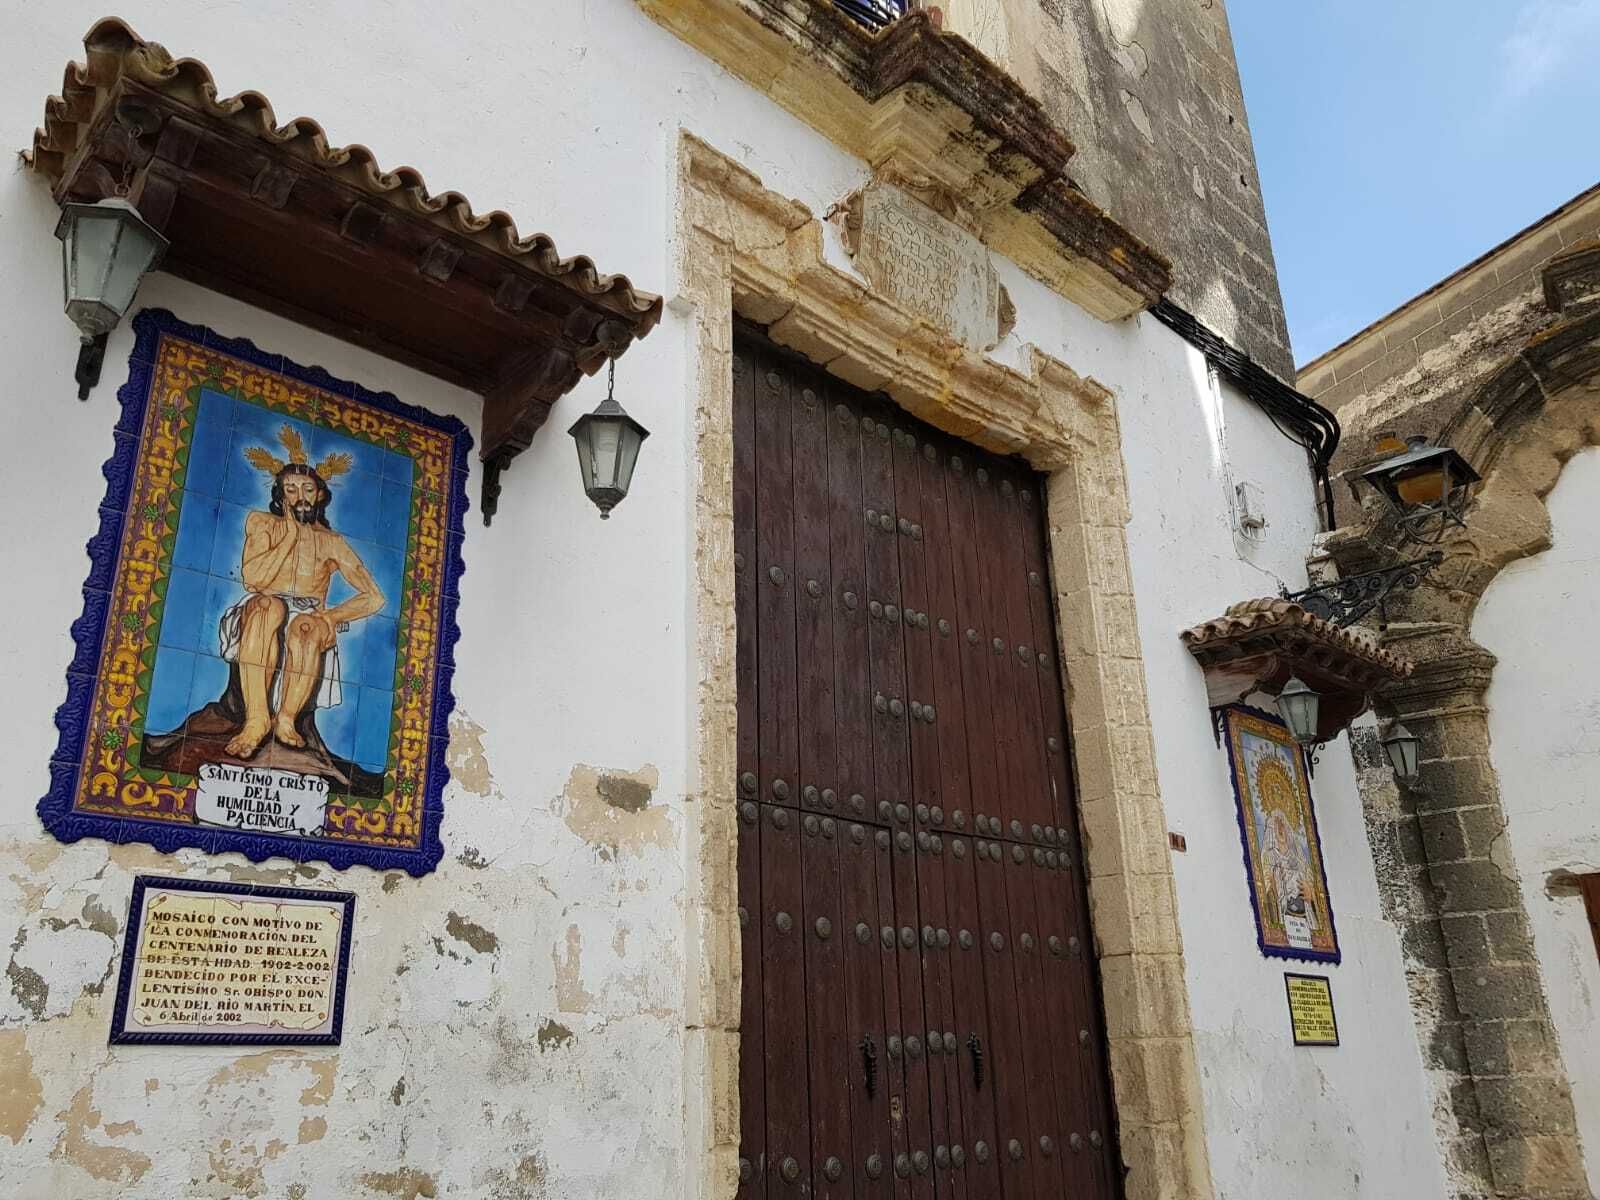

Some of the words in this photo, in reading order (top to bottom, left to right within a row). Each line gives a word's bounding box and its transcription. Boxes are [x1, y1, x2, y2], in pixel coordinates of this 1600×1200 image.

[279, 776, 324, 793] CRISTO
[244, 785, 262, 800] DE
[264, 788, 281, 802] LA
[217, 795, 282, 815] HUMILDAD
[289, 804, 301, 816] Y
[226, 810, 296, 830] PACIENCIA
[222, 915, 249, 926] CON
[305, 921, 322, 931] DE
[150, 926, 170, 936] LA
[291, 934, 317, 944] DEL
[245, 944, 263, 955] DE
[266, 946, 328, 958] REALEZA
[147, 954, 166, 964] DE
[260, 959, 330, 971] 1902-2002
[230, 973, 257, 983] POR
[262, 974, 280, 984] EL
[141, 998, 180, 1009] JUAN
[299, 1003, 315, 1013] EL
[159, 1011, 167, 1020] 6
[170, 1012, 198, 1022] Abril
[201, 1014, 213, 1022] de
[216, 1013, 242, 1022] 2002
